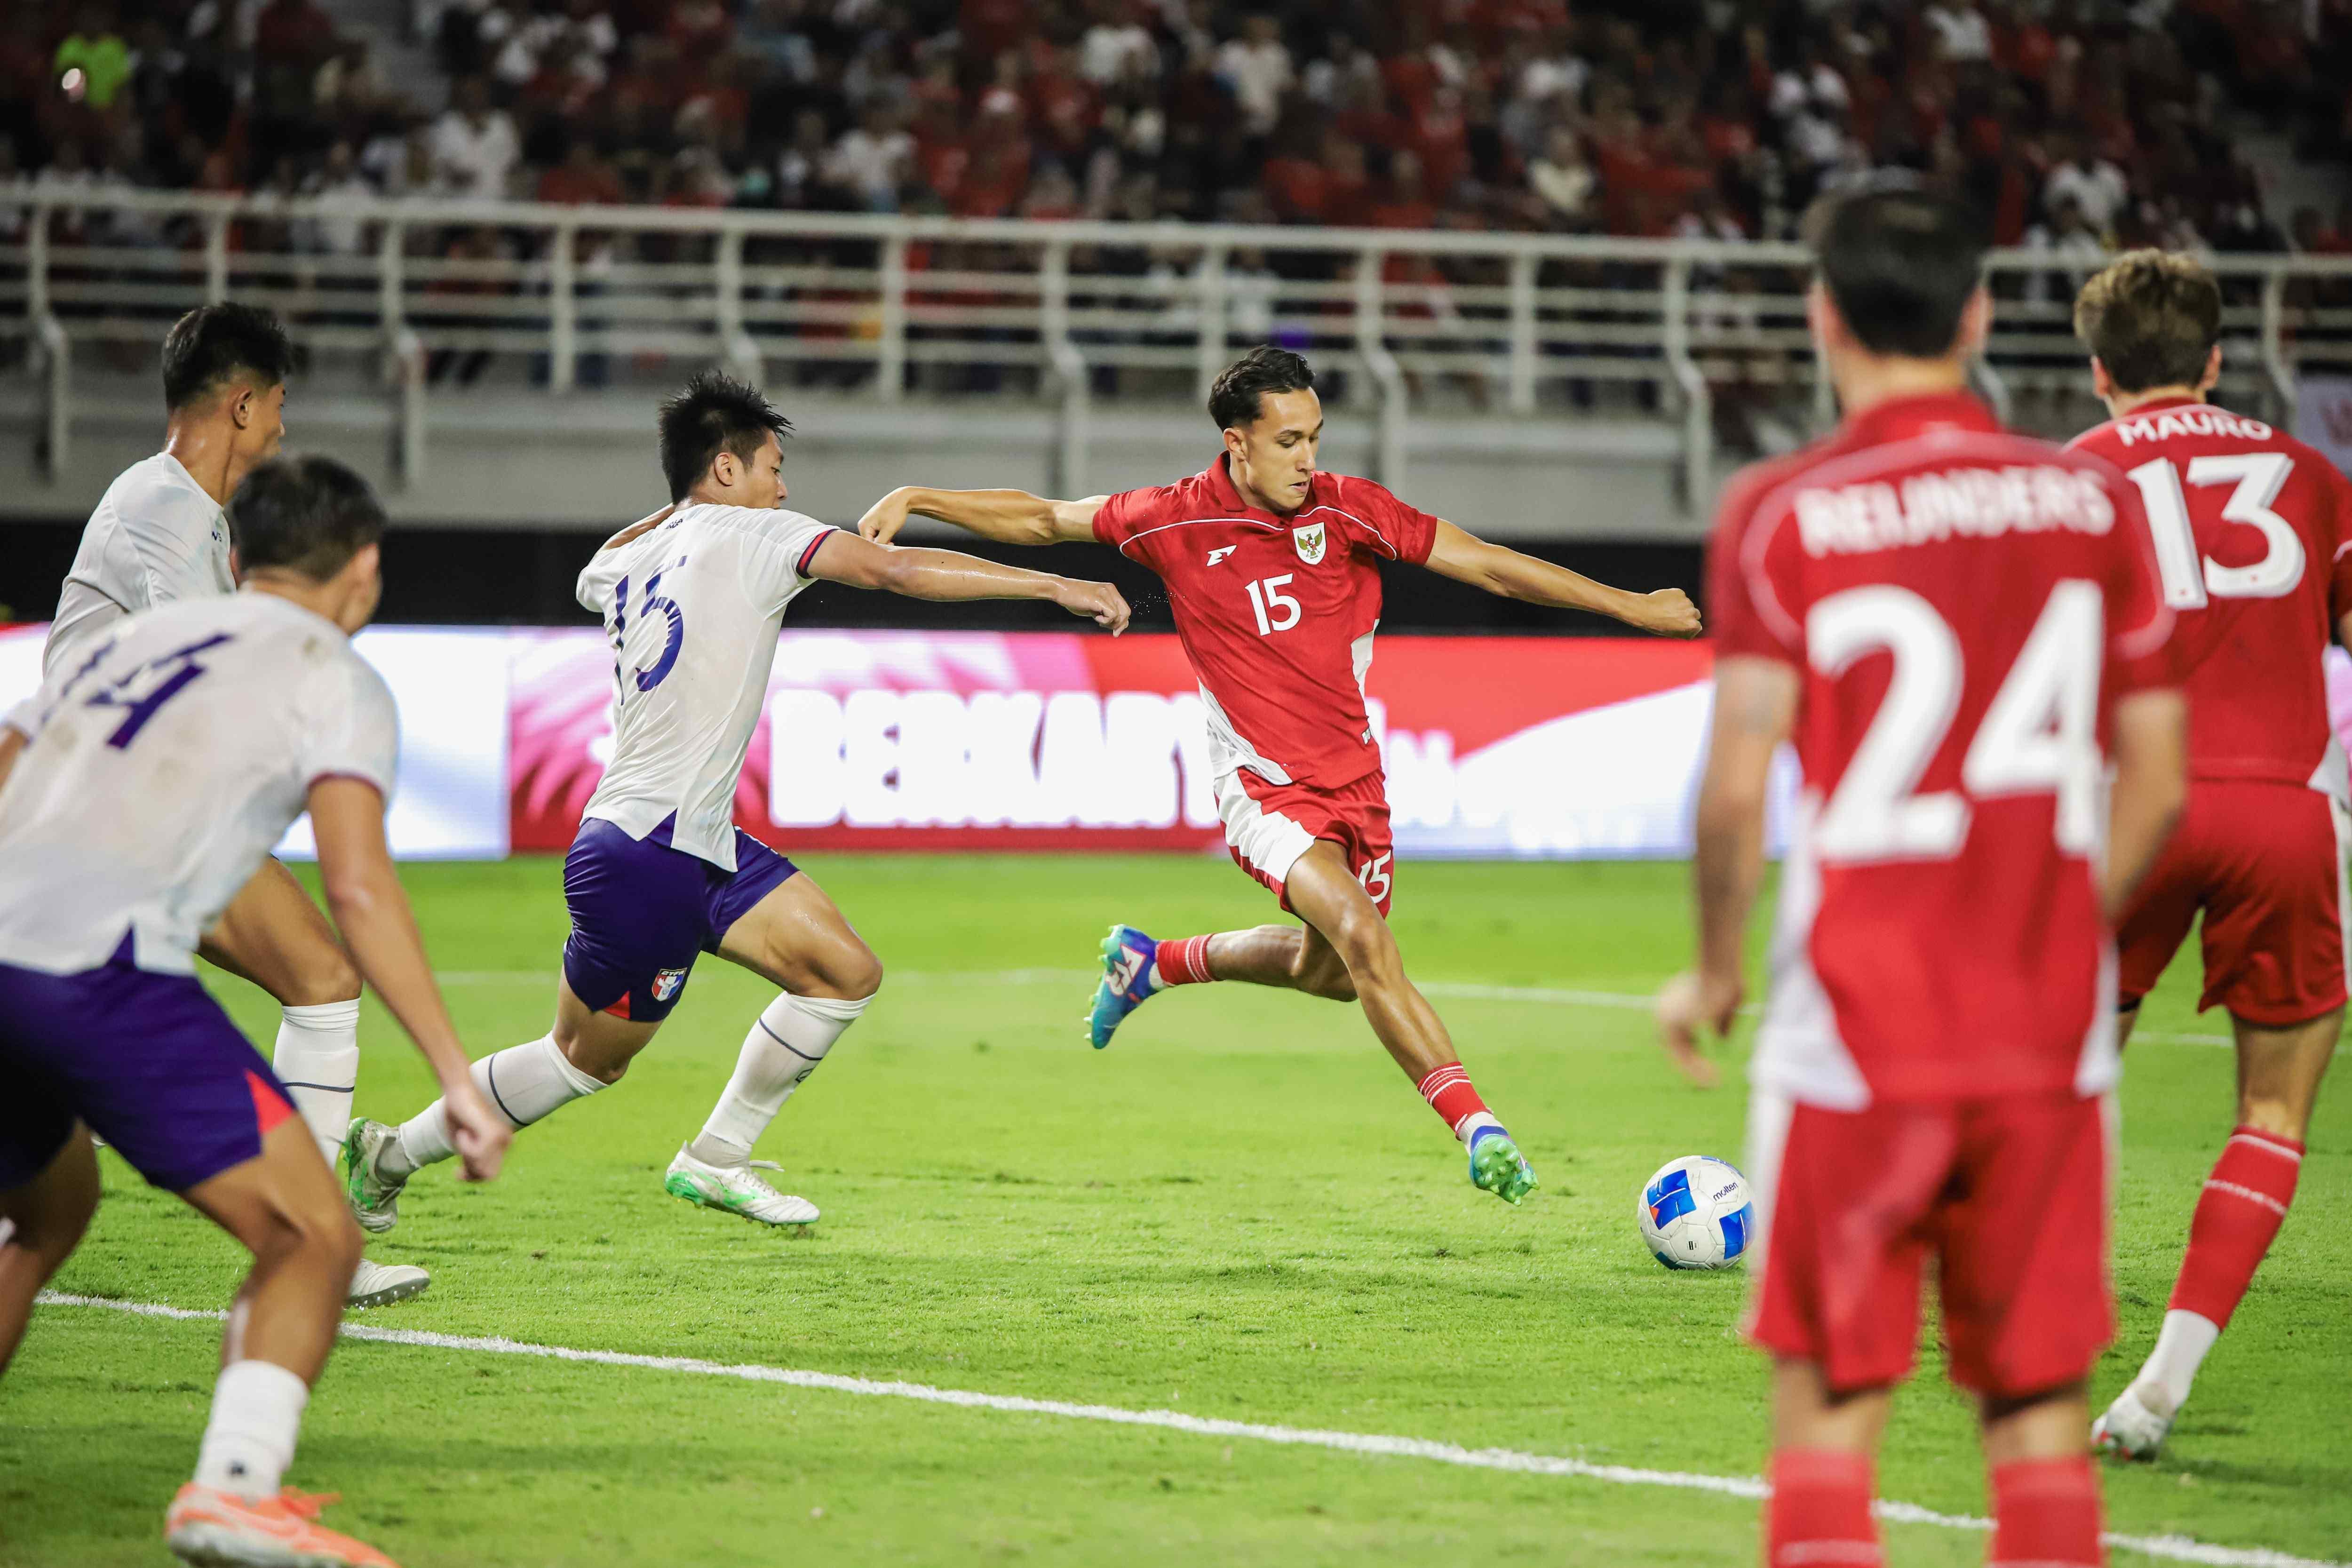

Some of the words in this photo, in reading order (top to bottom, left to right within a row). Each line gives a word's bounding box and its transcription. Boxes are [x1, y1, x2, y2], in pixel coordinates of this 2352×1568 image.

[2117, 412, 2273, 446] MAURO
[2126, 452, 2305, 609] 13
[612, 555, 687, 706] 15
[1244, 573, 1302, 637] 15
[1804, 578, 2105, 863] 24
[1358, 849, 1391, 904] 15
[1713, 1182, 1739, 1202] molten
